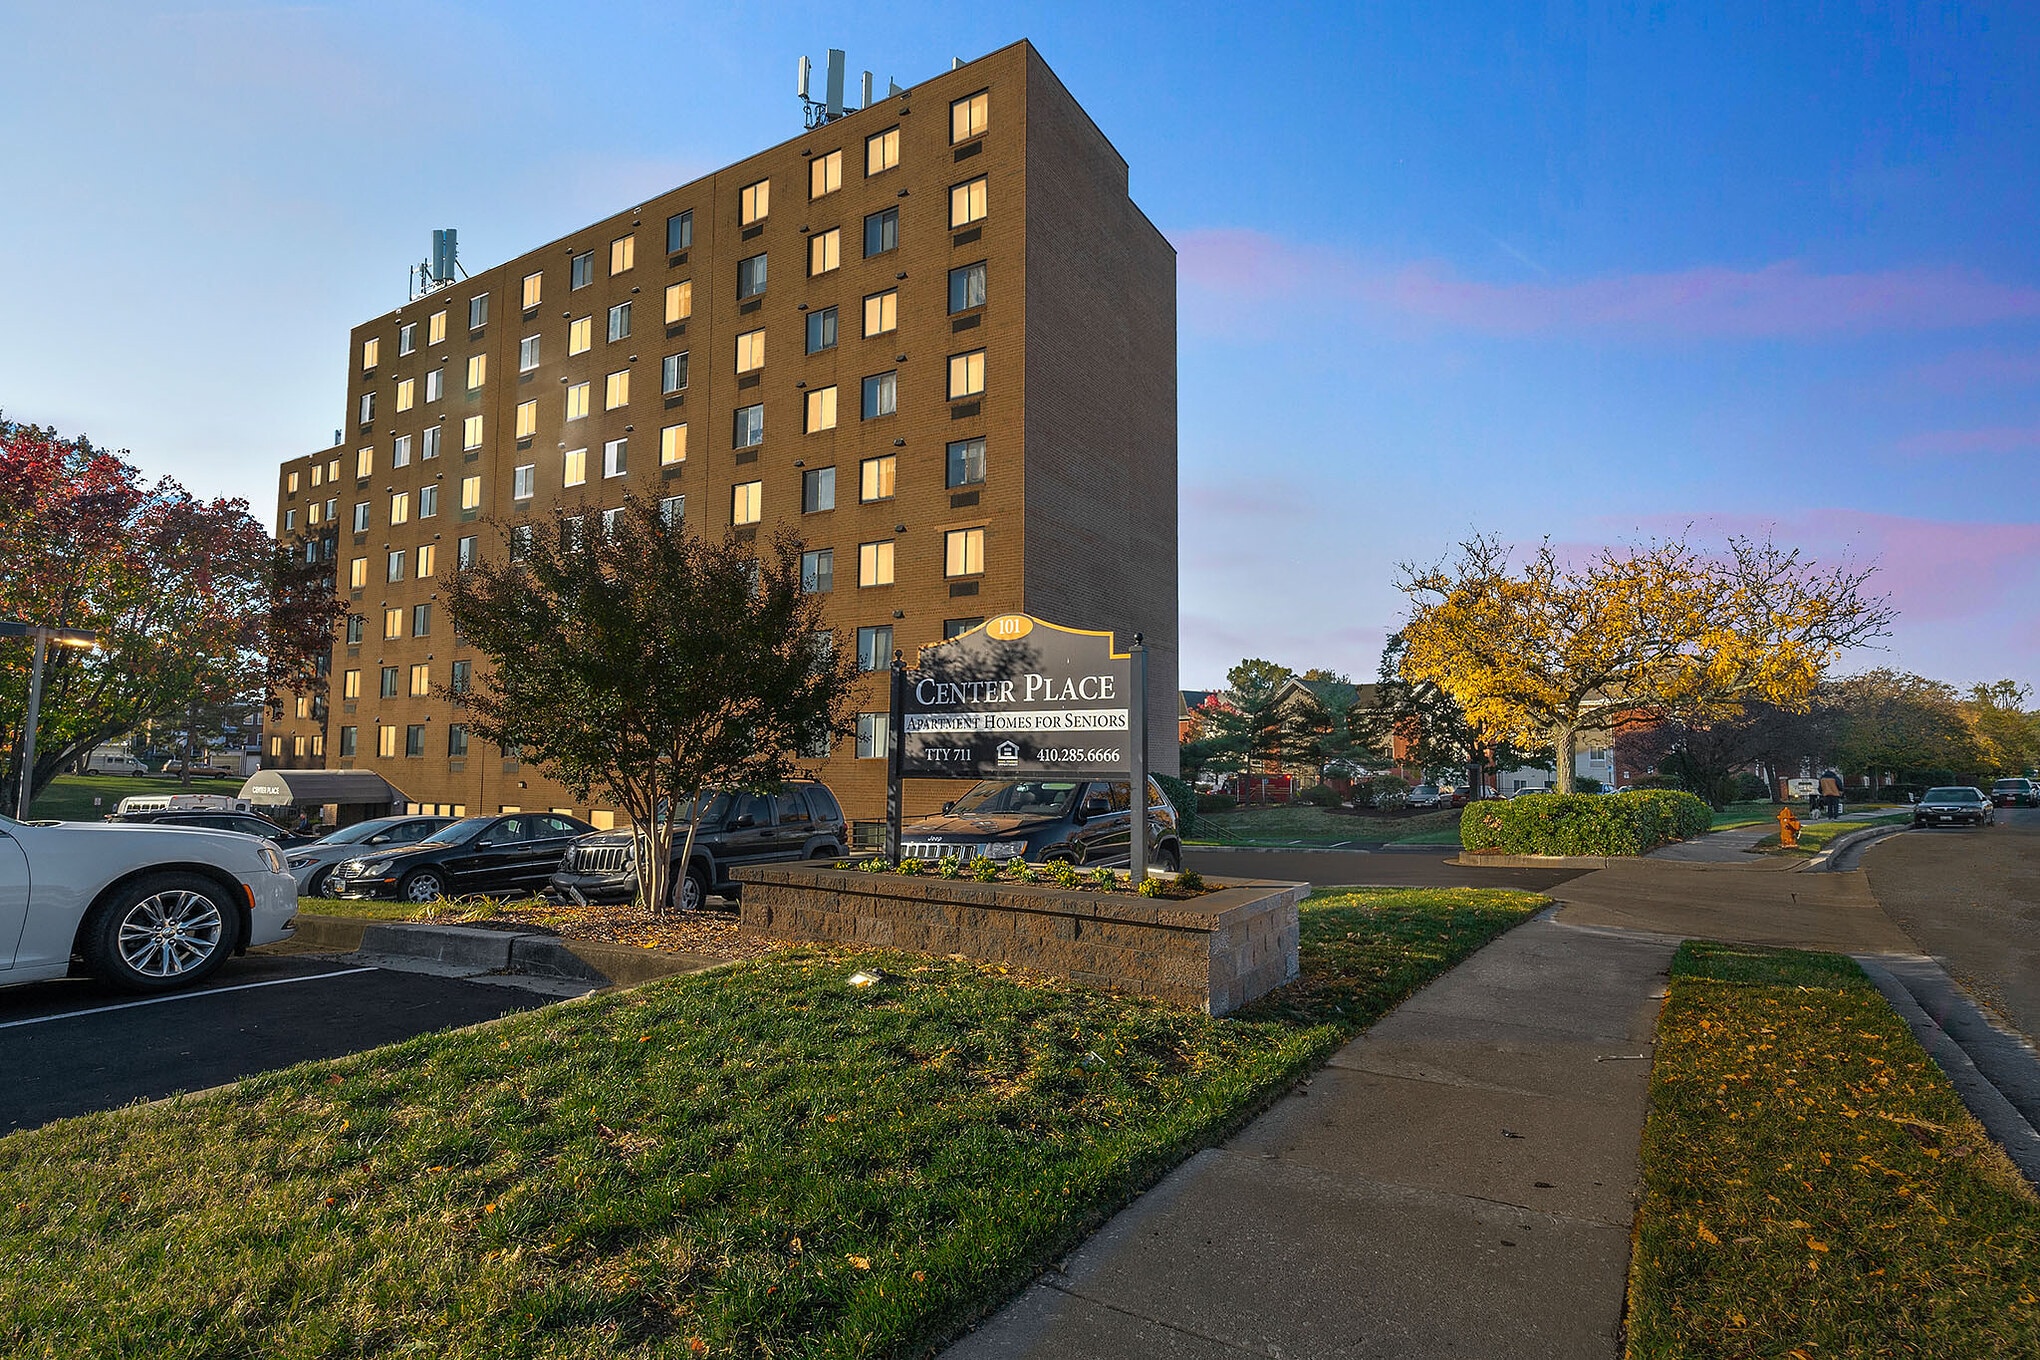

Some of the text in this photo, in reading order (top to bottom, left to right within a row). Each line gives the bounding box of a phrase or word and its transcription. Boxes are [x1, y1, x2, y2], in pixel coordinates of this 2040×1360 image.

[999, 619, 1020, 635] 101
[915, 673, 1116, 706] CENTER PLACE
[906, 713, 1126, 731] APARTMENT HOMES FOR SENIORS
[925, 748, 1120, 762] TTY 711 410.285.6666
